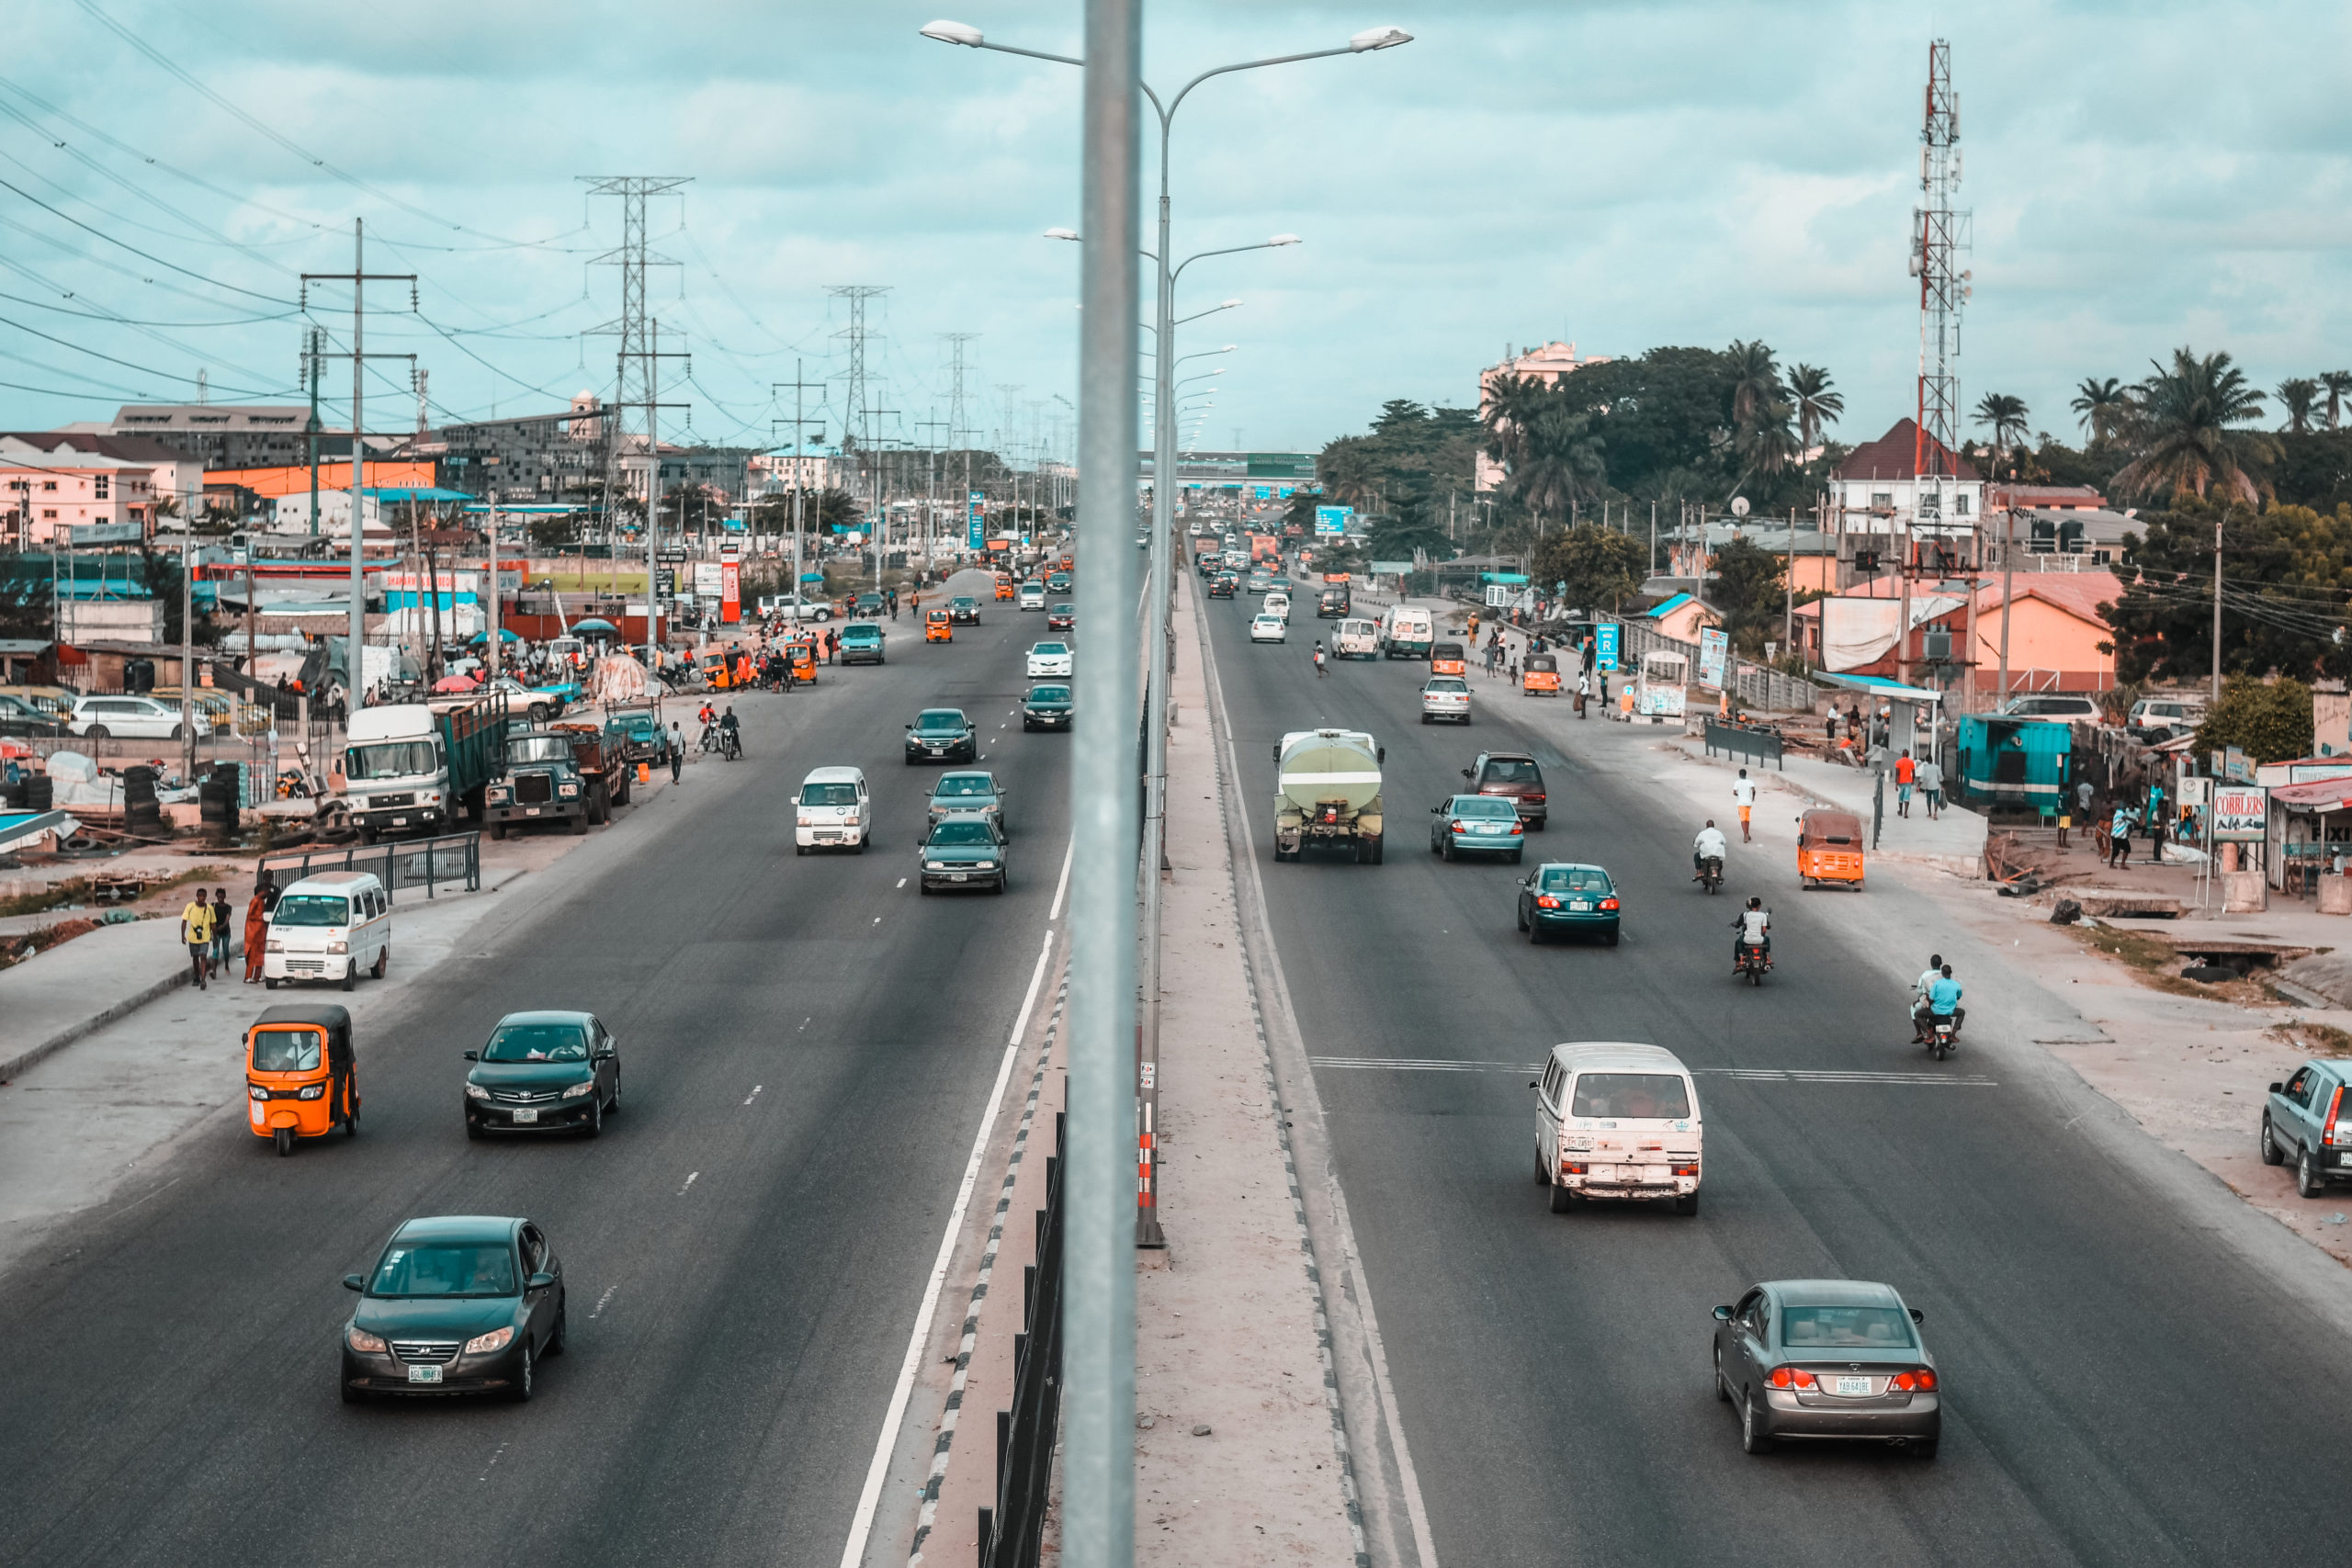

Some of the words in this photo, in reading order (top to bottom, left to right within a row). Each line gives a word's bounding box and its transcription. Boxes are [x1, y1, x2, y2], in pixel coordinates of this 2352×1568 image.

[388, 576, 419, 586] SHAWARM
[1603, 641, 1611, 651] R
[2215, 795, 2264, 816] COBBLERS
[2312, 827, 2352, 841] FIXI
